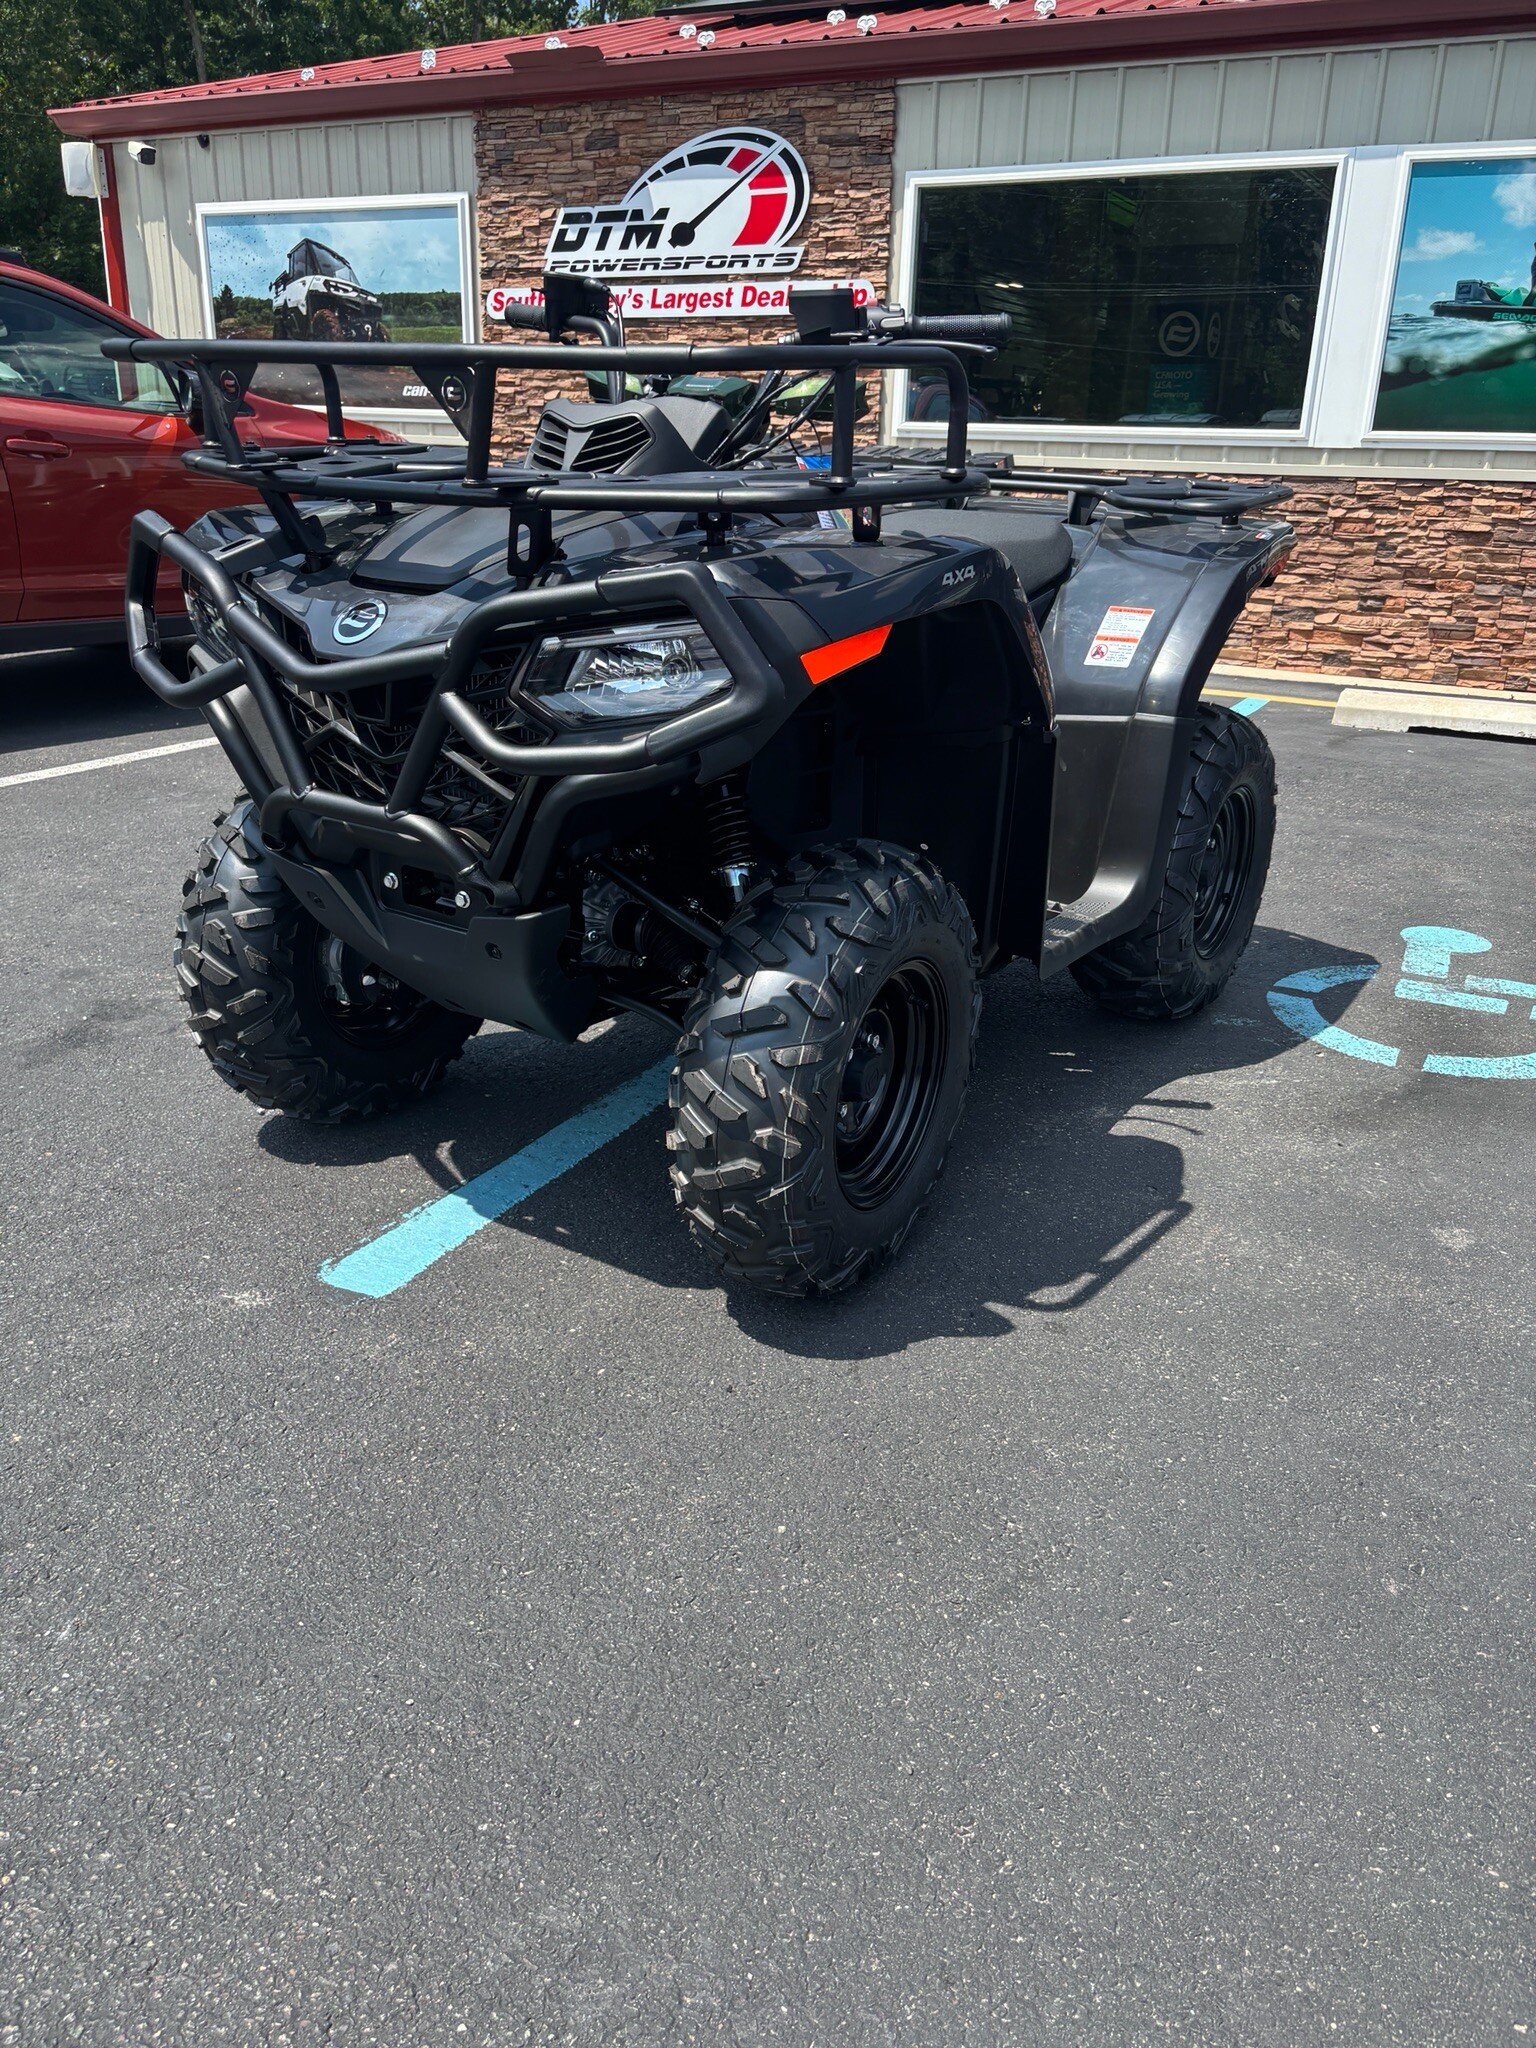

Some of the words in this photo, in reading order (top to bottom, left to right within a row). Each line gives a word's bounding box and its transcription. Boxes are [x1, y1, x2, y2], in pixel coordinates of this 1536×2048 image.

[551, 207, 670, 252] DTM
[550, 252, 798, 273] POWERSPORTS
[650, 287, 734, 313] Largest
